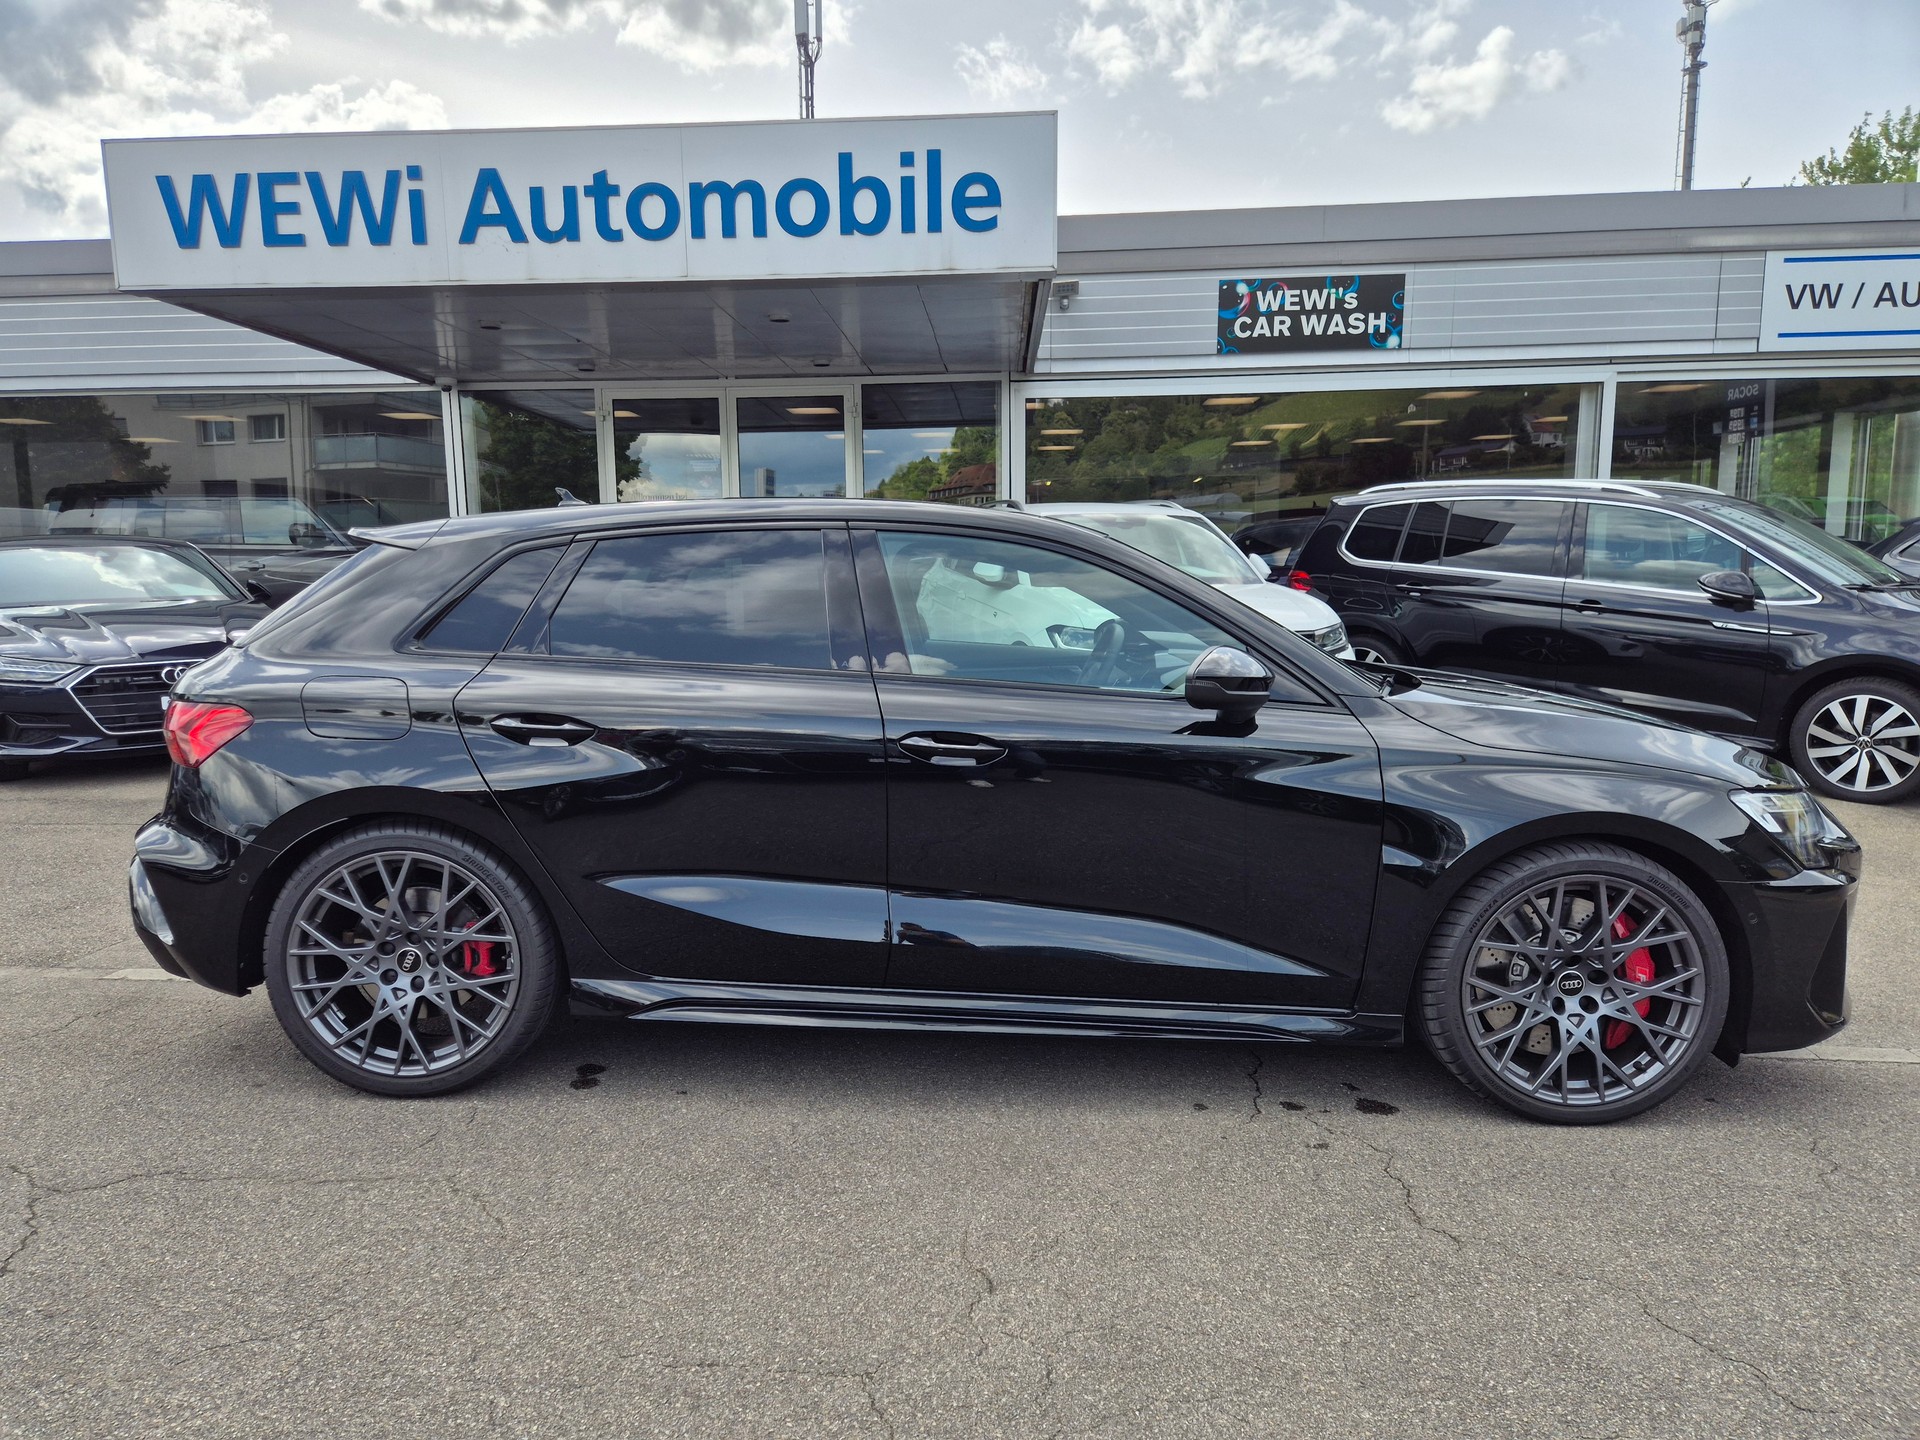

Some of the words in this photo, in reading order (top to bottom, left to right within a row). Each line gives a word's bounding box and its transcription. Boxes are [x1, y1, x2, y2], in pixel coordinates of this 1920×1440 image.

[155, 165, 428, 249] WEWi
[459, 149, 1002, 244] Automobile
[1256, 287, 1358, 312] WEWi's
[1785, 283, 1844, 310] VW
[1851, 282, 1865, 309] /
[1234, 315, 1292, 339] CAR
[1301, 312, 1387, 336] WASH
[461, 854, 513, 900] BRIDGESTONE
[1646, 875, 1691, 909] BRIDGESTONE
[1468, 899, 1499, 934] POTENZA
